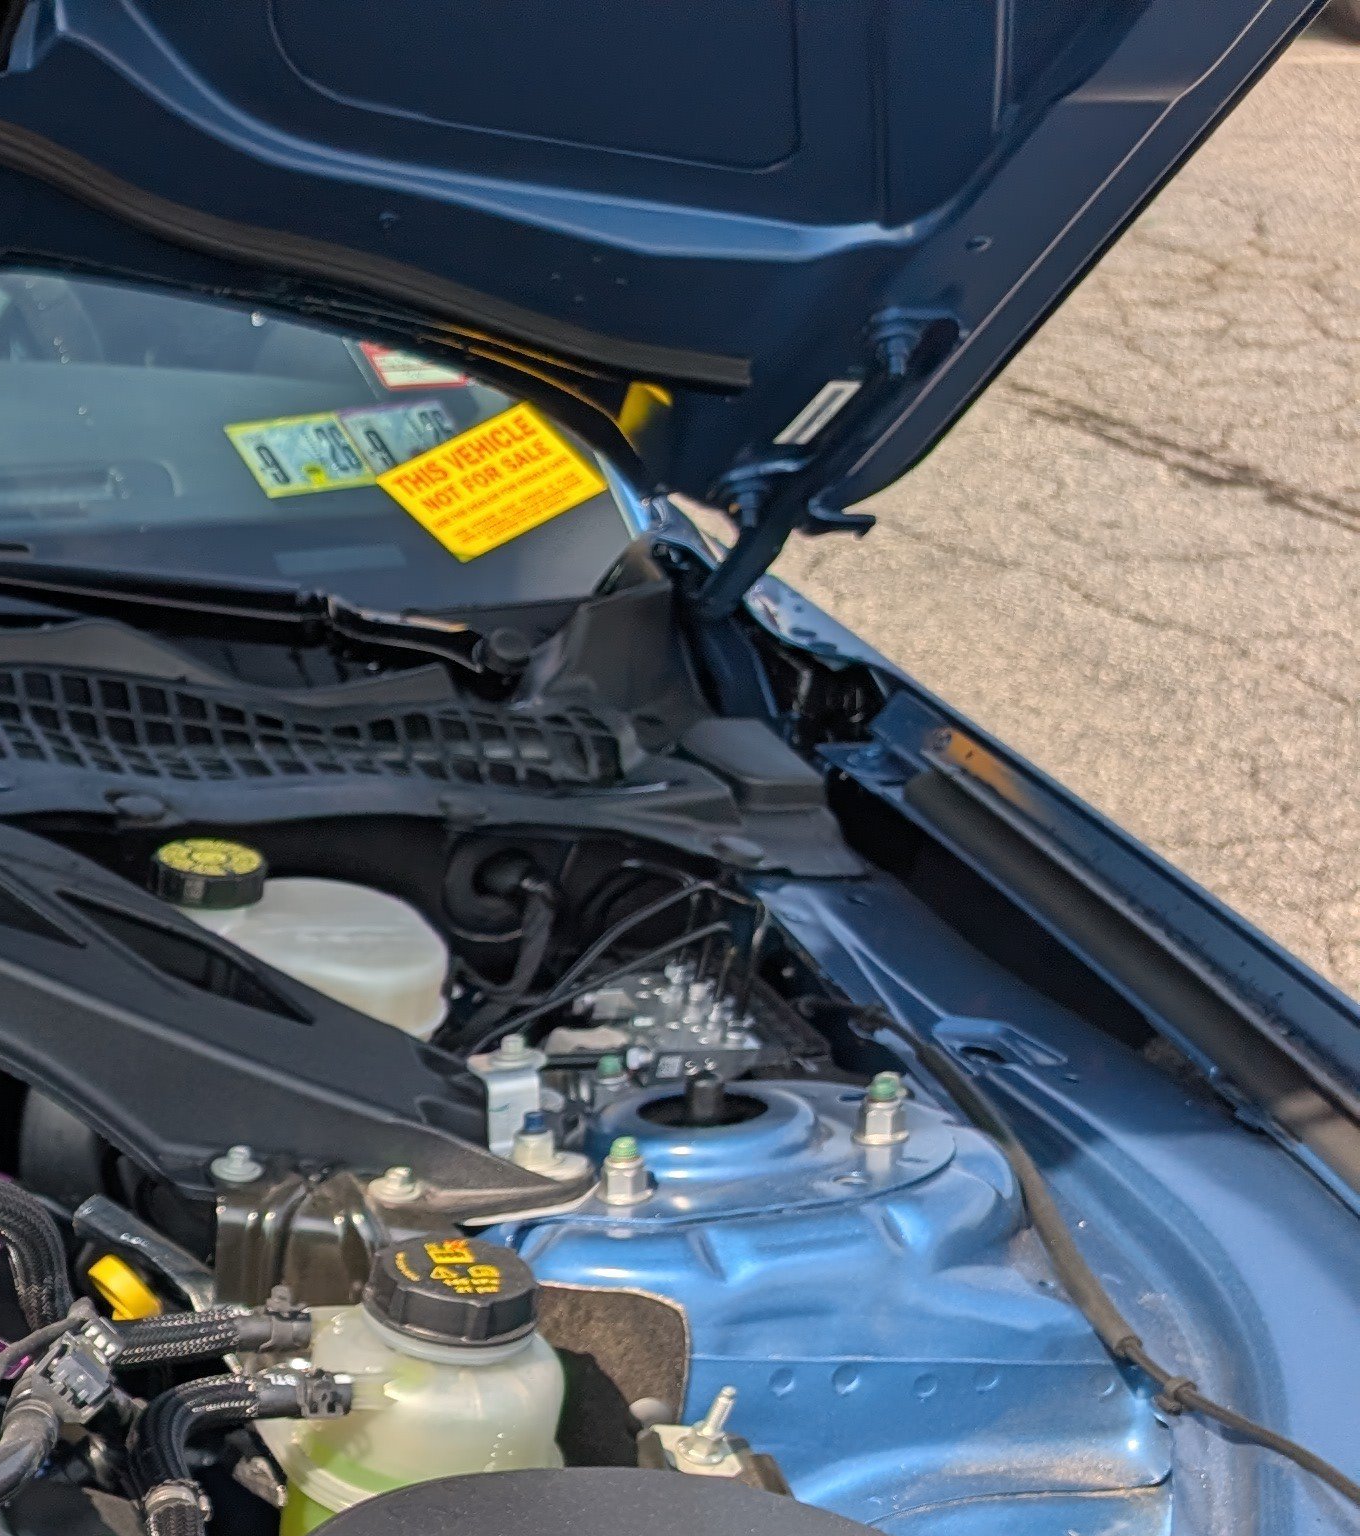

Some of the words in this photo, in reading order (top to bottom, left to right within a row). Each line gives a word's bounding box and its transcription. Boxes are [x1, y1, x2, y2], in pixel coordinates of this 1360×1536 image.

[393, 450, 450, 500] THIS
[450, 414, 540, 472] VEHICLE
[420, 481, 466, 515] NOT
[465, 463, 502, 497] FOR
[504, 439, 551, 474] SALE
